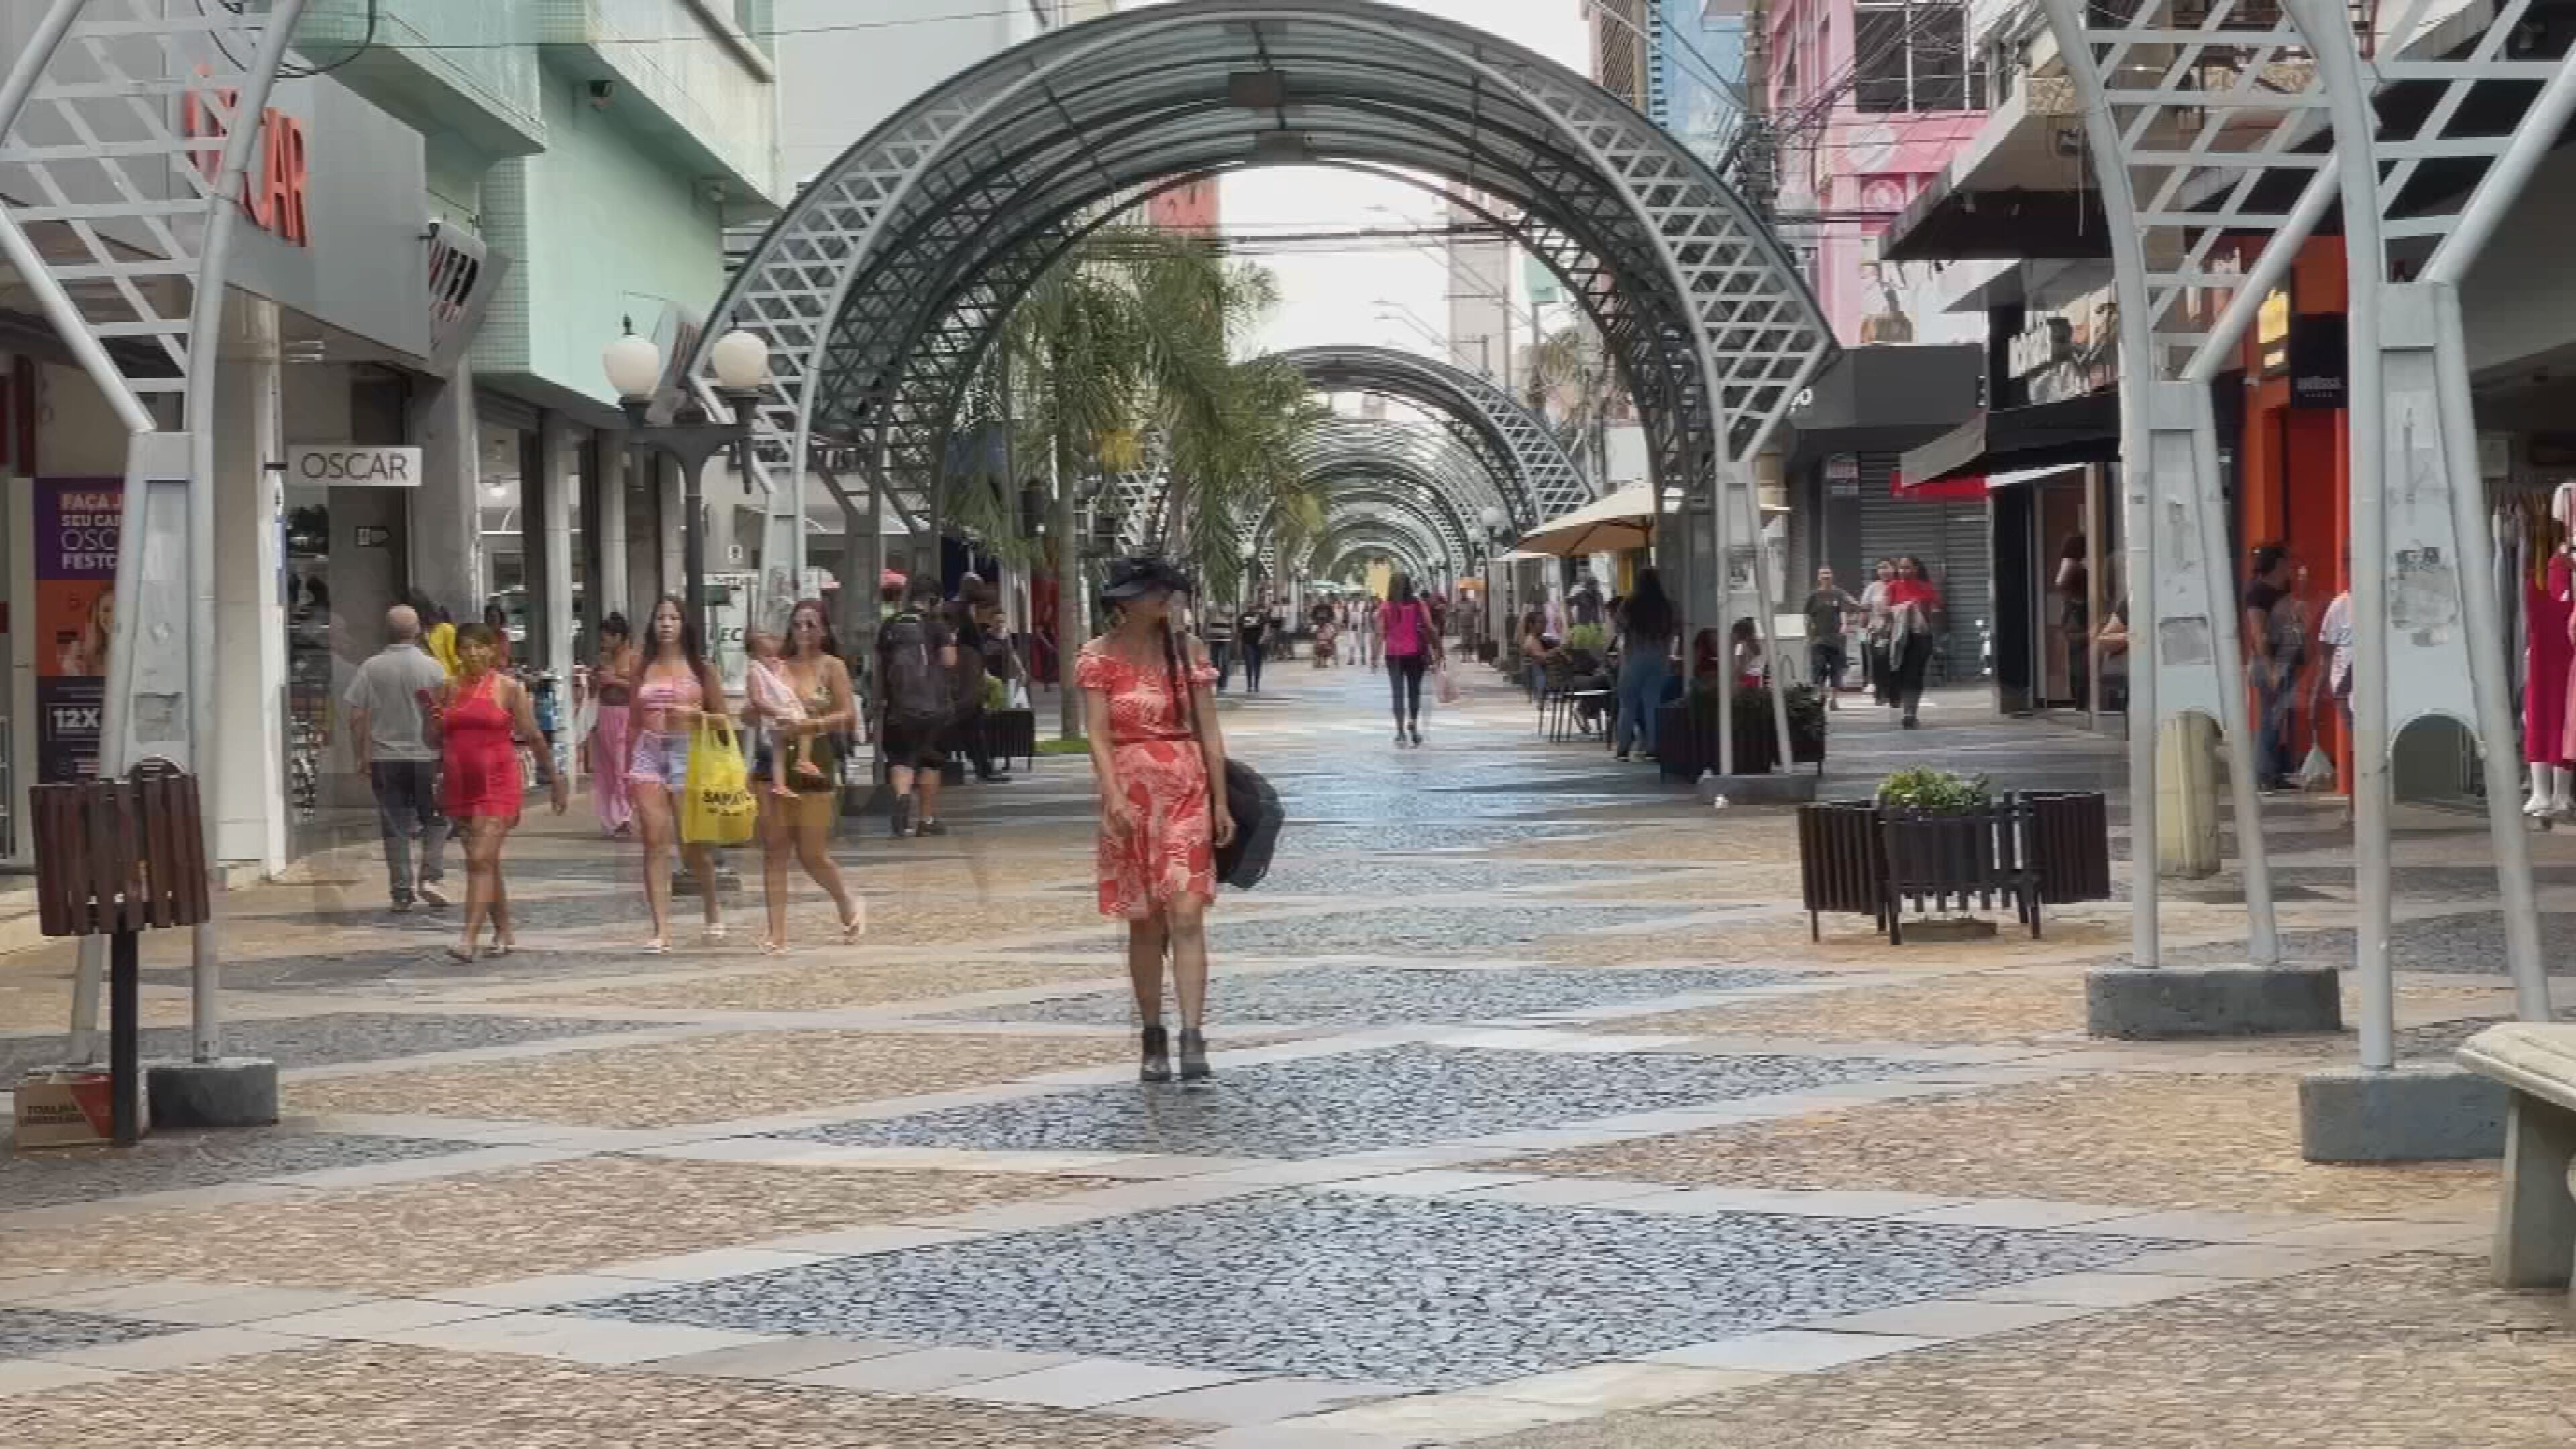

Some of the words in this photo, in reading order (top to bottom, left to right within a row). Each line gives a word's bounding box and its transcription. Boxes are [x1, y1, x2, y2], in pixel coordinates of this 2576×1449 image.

[302, 453, 408, 480] OSCAR
[61, 515, 91, 527] SEU
[54, 708, 101, 729] 12X
